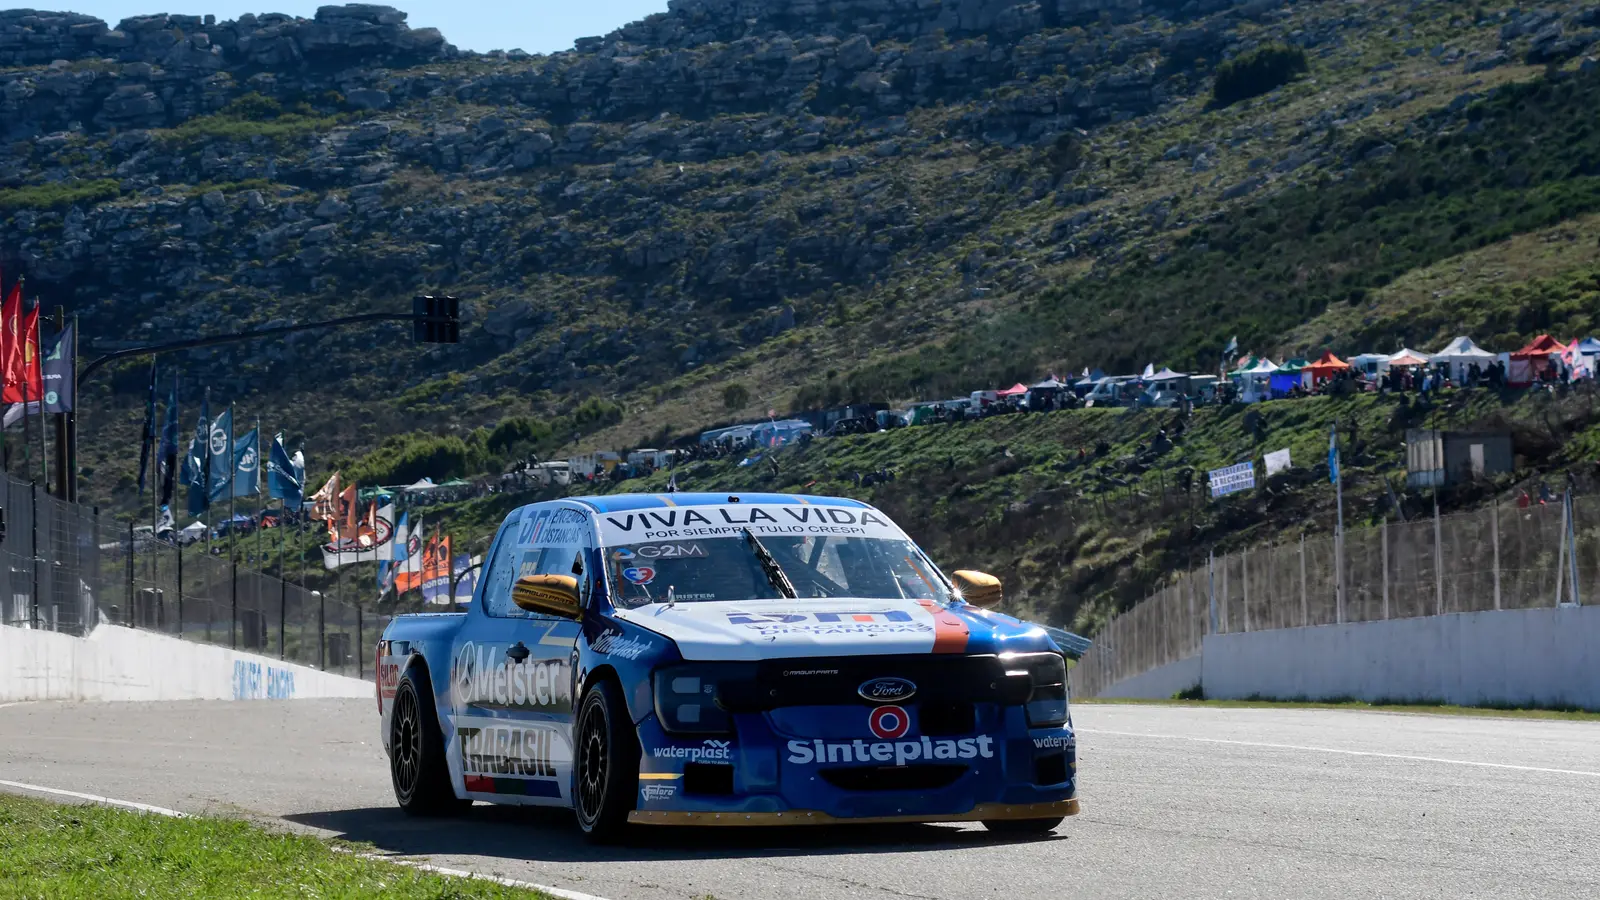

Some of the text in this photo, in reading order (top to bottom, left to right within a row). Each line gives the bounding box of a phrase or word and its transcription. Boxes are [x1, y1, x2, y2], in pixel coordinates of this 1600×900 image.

[606, 508, 889, 531] VIVA LA VIDA
[540, 528, 582, 544] DISTANCIAS
[645, 525, 865, 539] POR SIEMPRE TULIO CRESPI
[637, 544, 703, 557] G2M
[474, 644, 560, 706] Meister
[872, 681, 903, 696] Ford
[457, 727, 558, 778] TRABASIL
[653, 745, 730, 762] waterplast
[787, 734, 994, 766] Sinteplast
